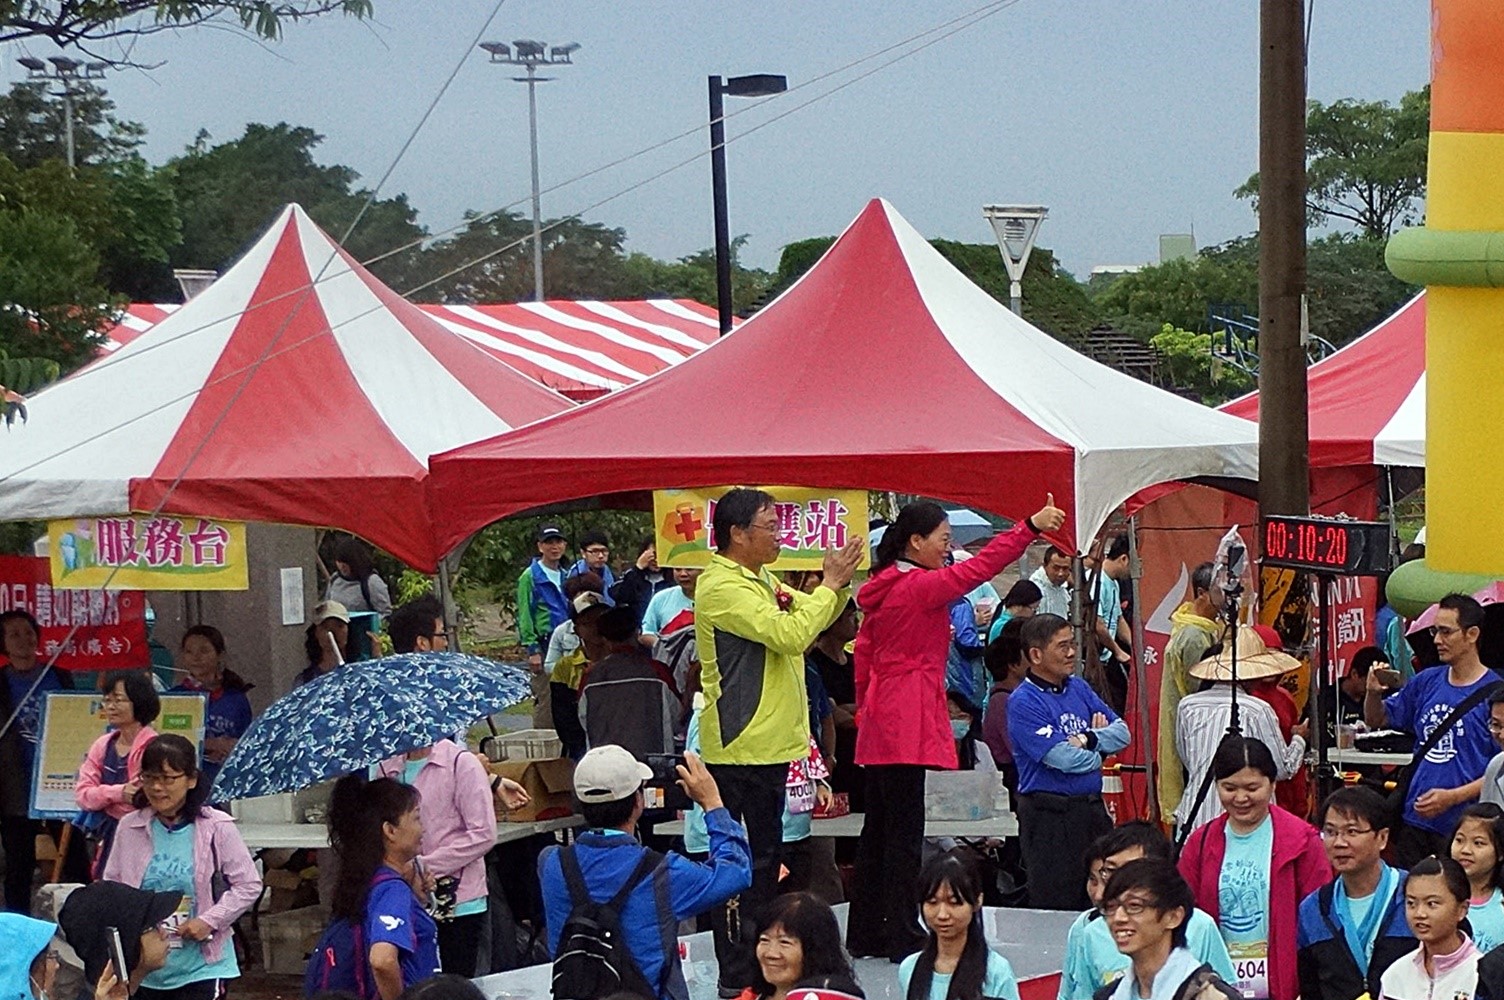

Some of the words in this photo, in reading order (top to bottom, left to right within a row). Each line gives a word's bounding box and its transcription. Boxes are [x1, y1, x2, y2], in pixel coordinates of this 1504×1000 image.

[96, 518, 230, 567] 服務台
[1267, 521, 1347, 565] 00:10:20
